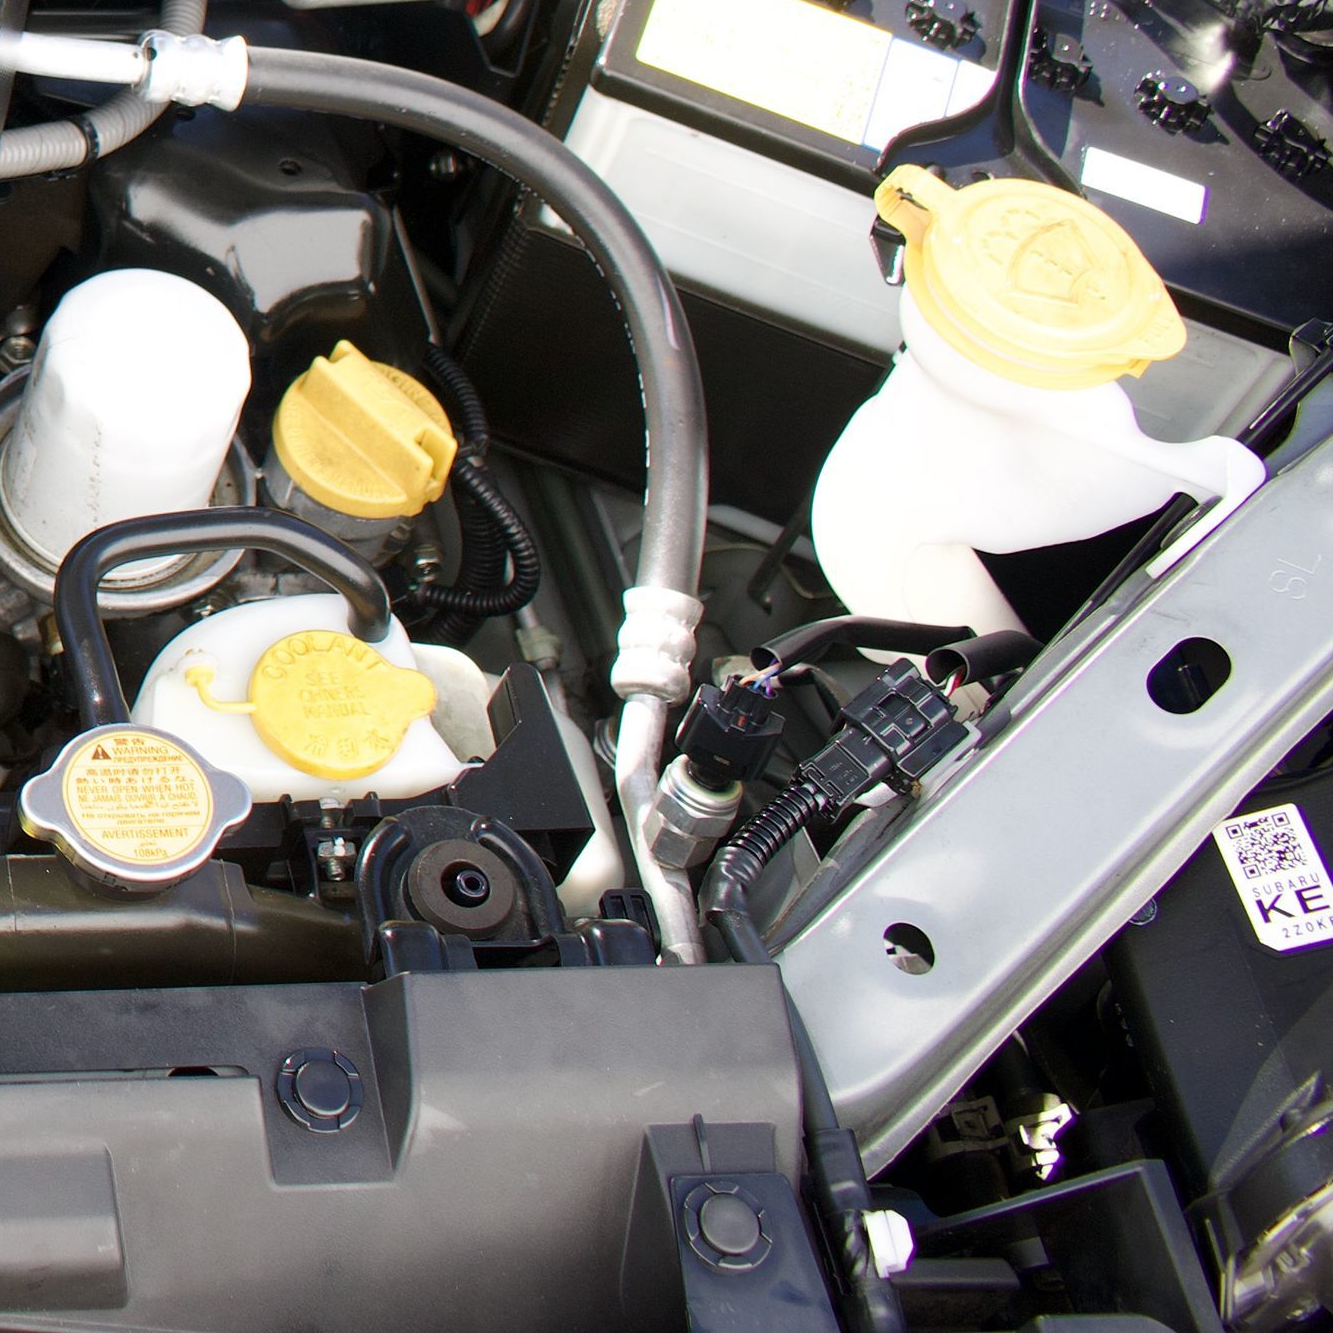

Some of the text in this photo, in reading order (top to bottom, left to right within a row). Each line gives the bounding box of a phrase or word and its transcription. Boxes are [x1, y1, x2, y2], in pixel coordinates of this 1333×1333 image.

[261, 633, 390, 681] COOLANT
[304, 670, 342, 687] SEE
[302, 701, 373, 720] MANUAL
[111, 746, 168, 756] WARNING
[76, 785, 108, 795] NEVER
[112, 784, 138, 795] OPEN
[142, 783, 171, 793] WHEN
[77, 794, 88, 803] NE
[92, 794, 121, 803] JAMAIS
[101, 827, 189, 839] AVERTISSEMENT
[1251, 872, 1321, 899] SUBARU
[1255, 884, 1331, 924] KE
